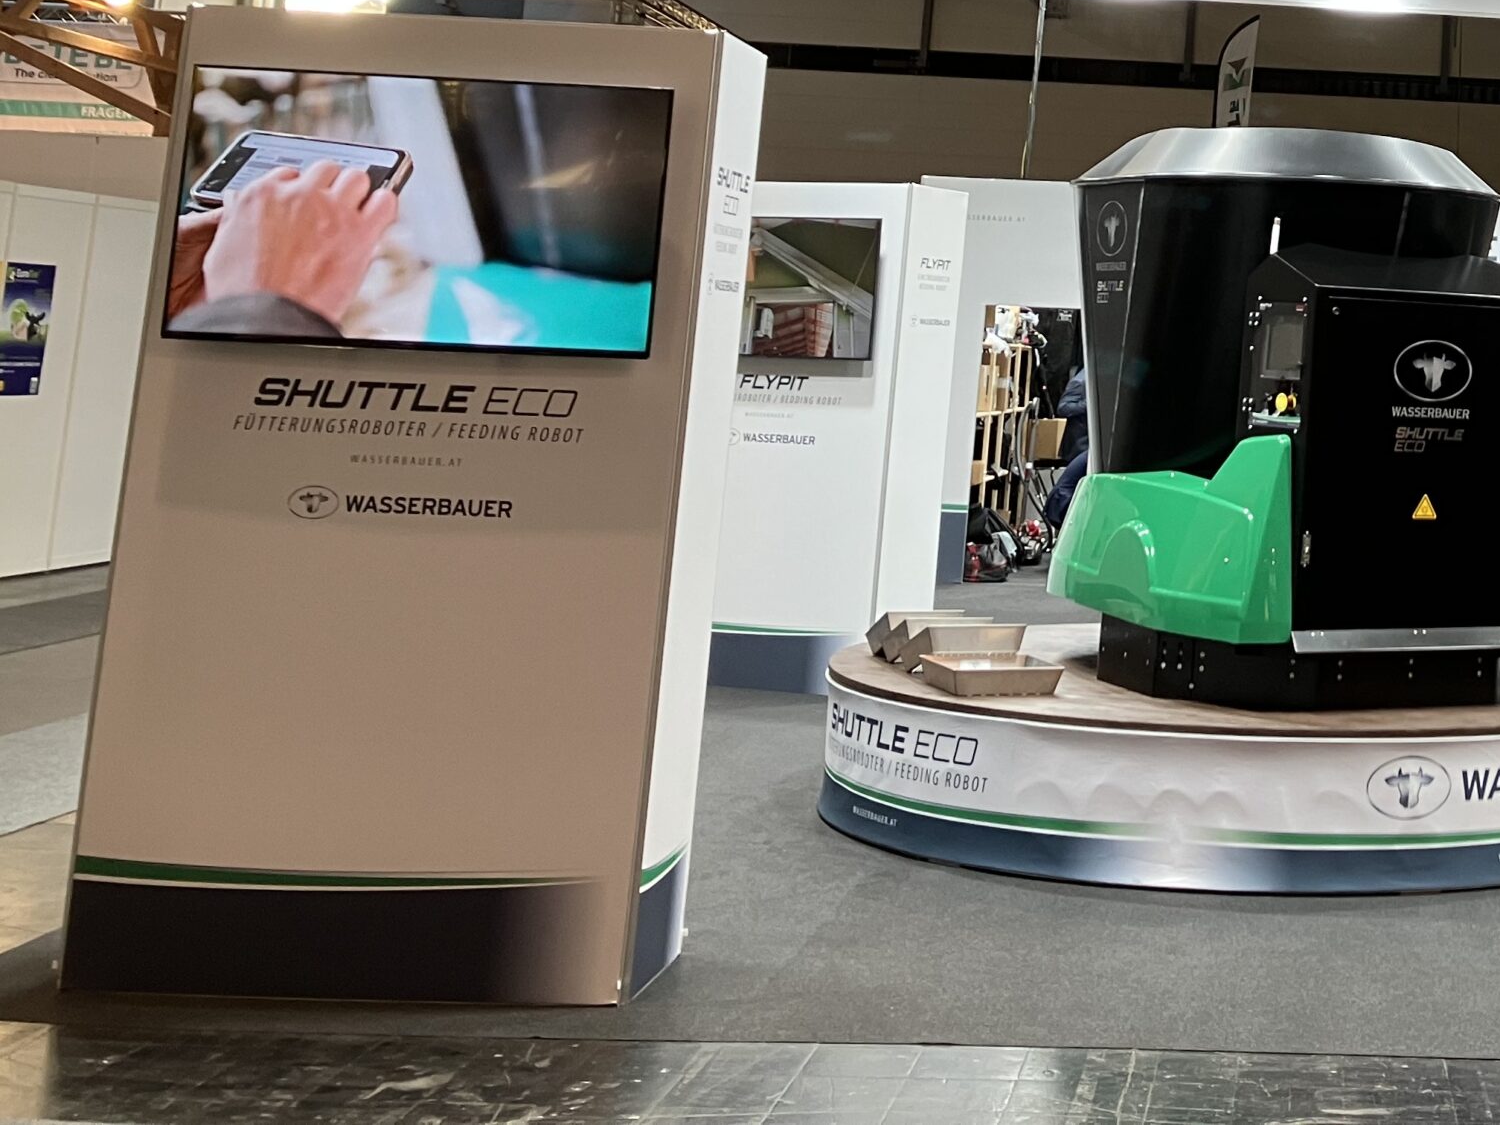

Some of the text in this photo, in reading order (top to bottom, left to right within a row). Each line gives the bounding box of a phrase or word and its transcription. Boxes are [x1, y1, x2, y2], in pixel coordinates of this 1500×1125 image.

[920, 258, 951, 270] FLYPIT
[739, 374, 809, 391] FLYPIT
[254, 377, 578, 418] SHUTTLE ECO
[1391, 406, 1470, 420] WASSERBAUER
[233, 413, 426, 437] FÜTTERUNGSROBOTER
[448, 422, 521, 442] FEEDING
[527, 427, 585, 444] ROBOT
[1395, 426, 1465, 442] SHUTTLE
[743, 433, 816, 445] WASSERBAUER
[1394, 440, 1425, 452] ECO
[350, 454, 463, 468] WASSERBAUER.AT
[346, 495, 513, 519] WASSERBAUER
[831, 703, 979, 767] SHUTTLE ECO
[895, 761, 940, 786] FEEDING
[944, 771, 989, 793] ROBOT
